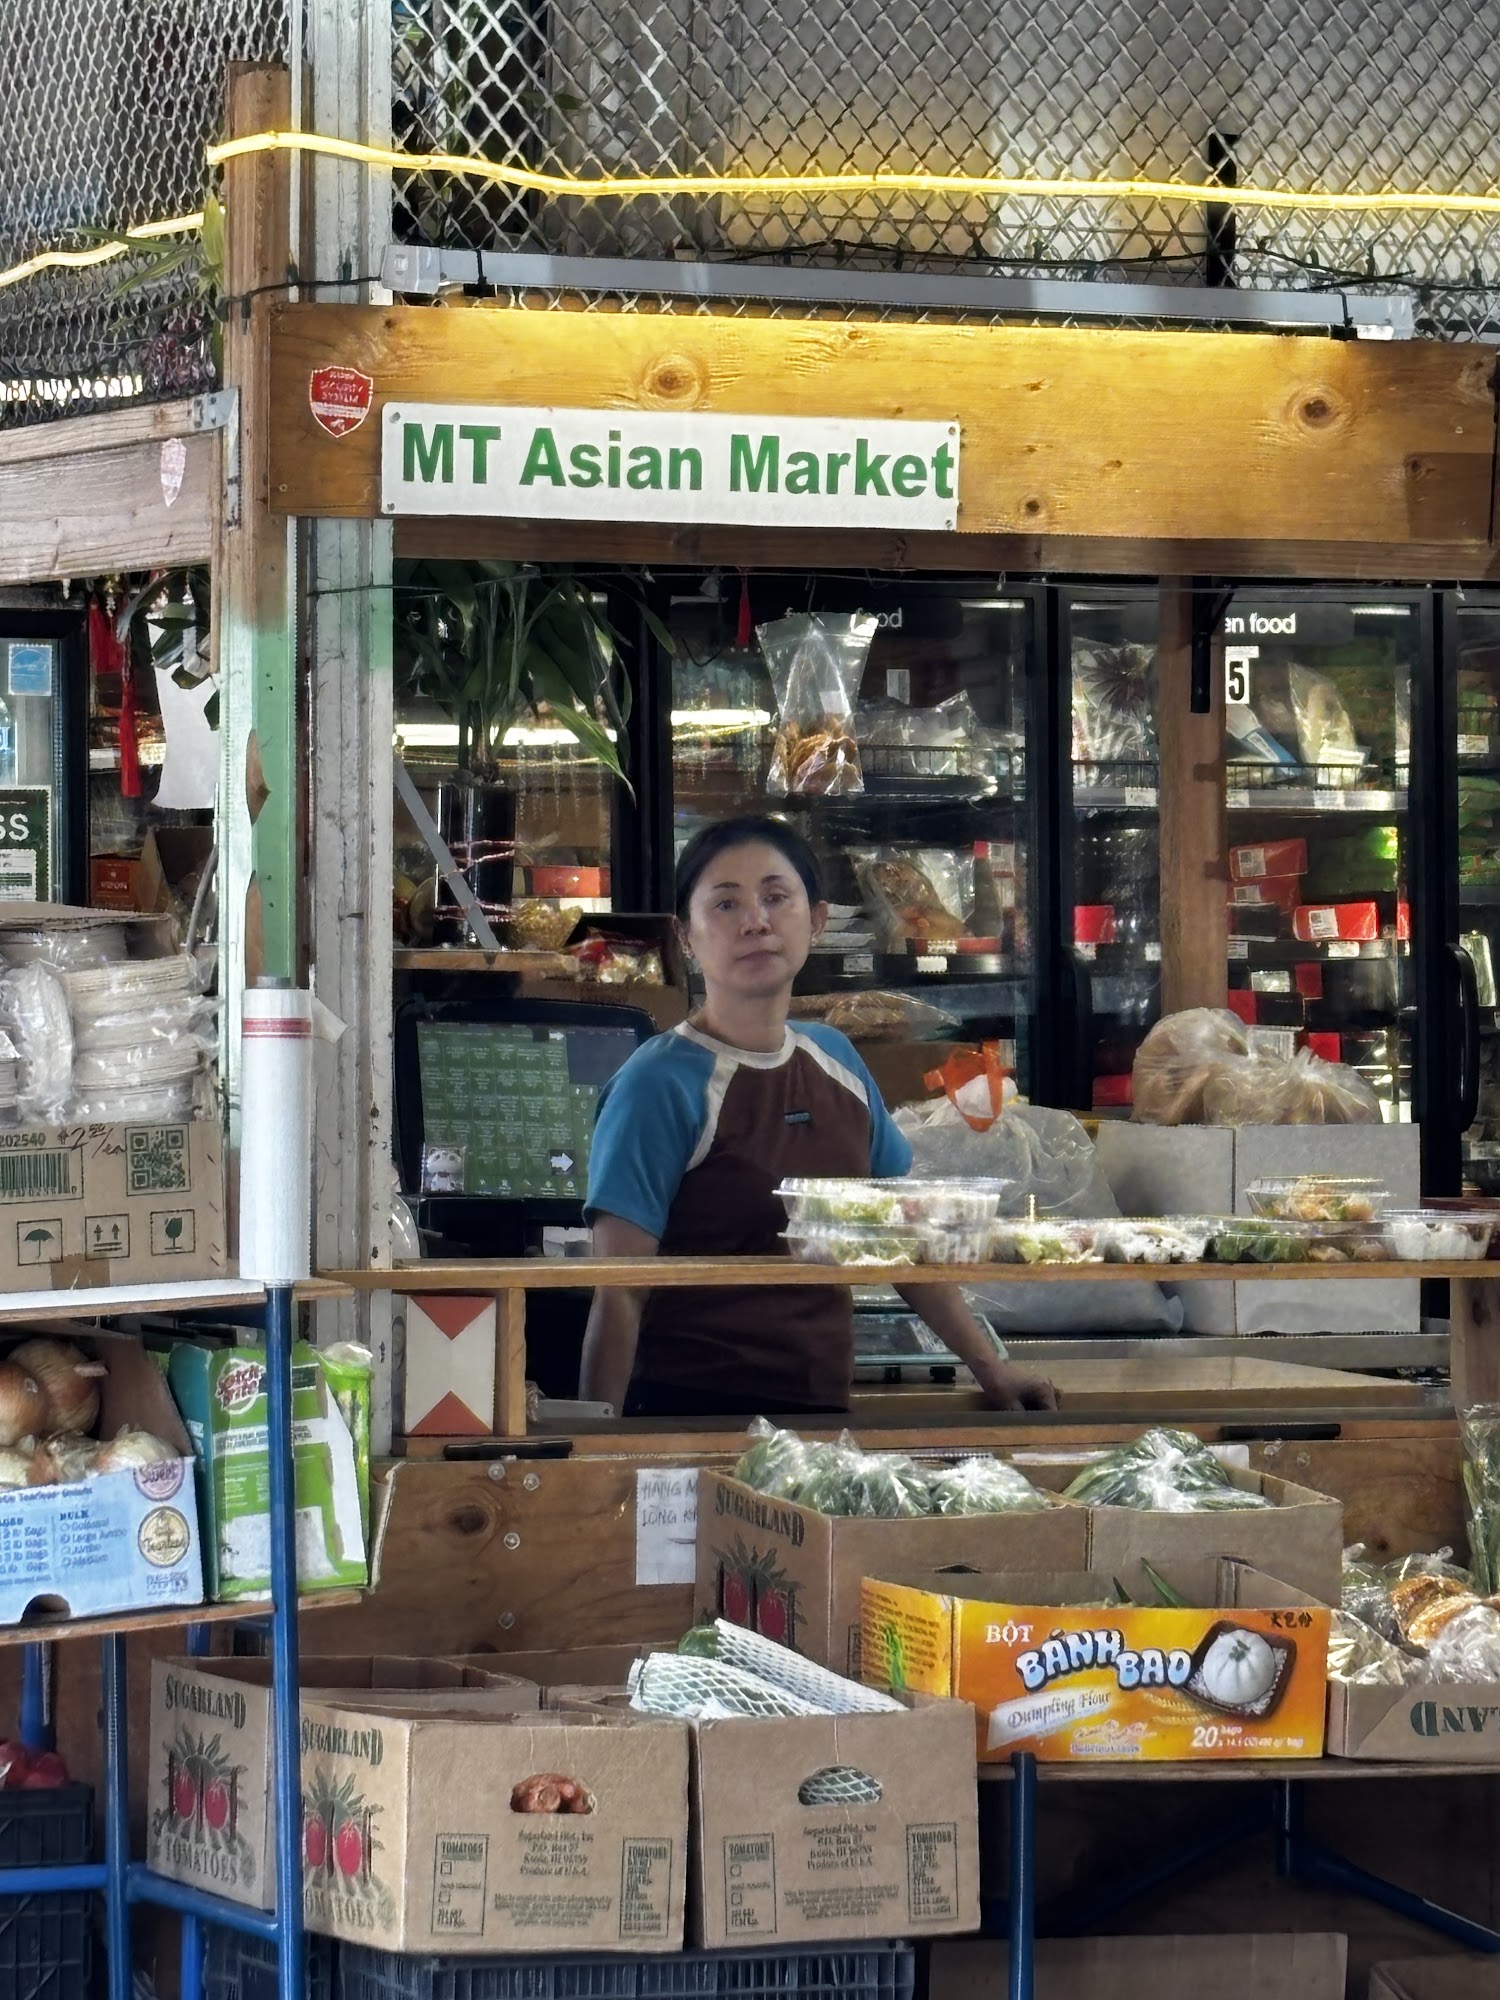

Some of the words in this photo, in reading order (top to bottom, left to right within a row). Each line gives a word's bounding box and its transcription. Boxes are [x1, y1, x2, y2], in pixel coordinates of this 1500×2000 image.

[403, 422, 501, 484] MT
[519, 427, 702, 490] Asian
[730, 434, 955, 499] Market
[1250, 612, 1296, 634] food
[1229, 661, 1245, 701] 5
[1015, 1627, 1125, 1694] BÁNH
[1115, 1648, 1194, 1692] BAO
[164, 1673, 247, 1730] SUGARLAND
[1007, 1696, 1076, 1729] Dumpling
[1079, 1689, 1112, 1709] Flour
[1191, 1725, 1219, 1748] 20
